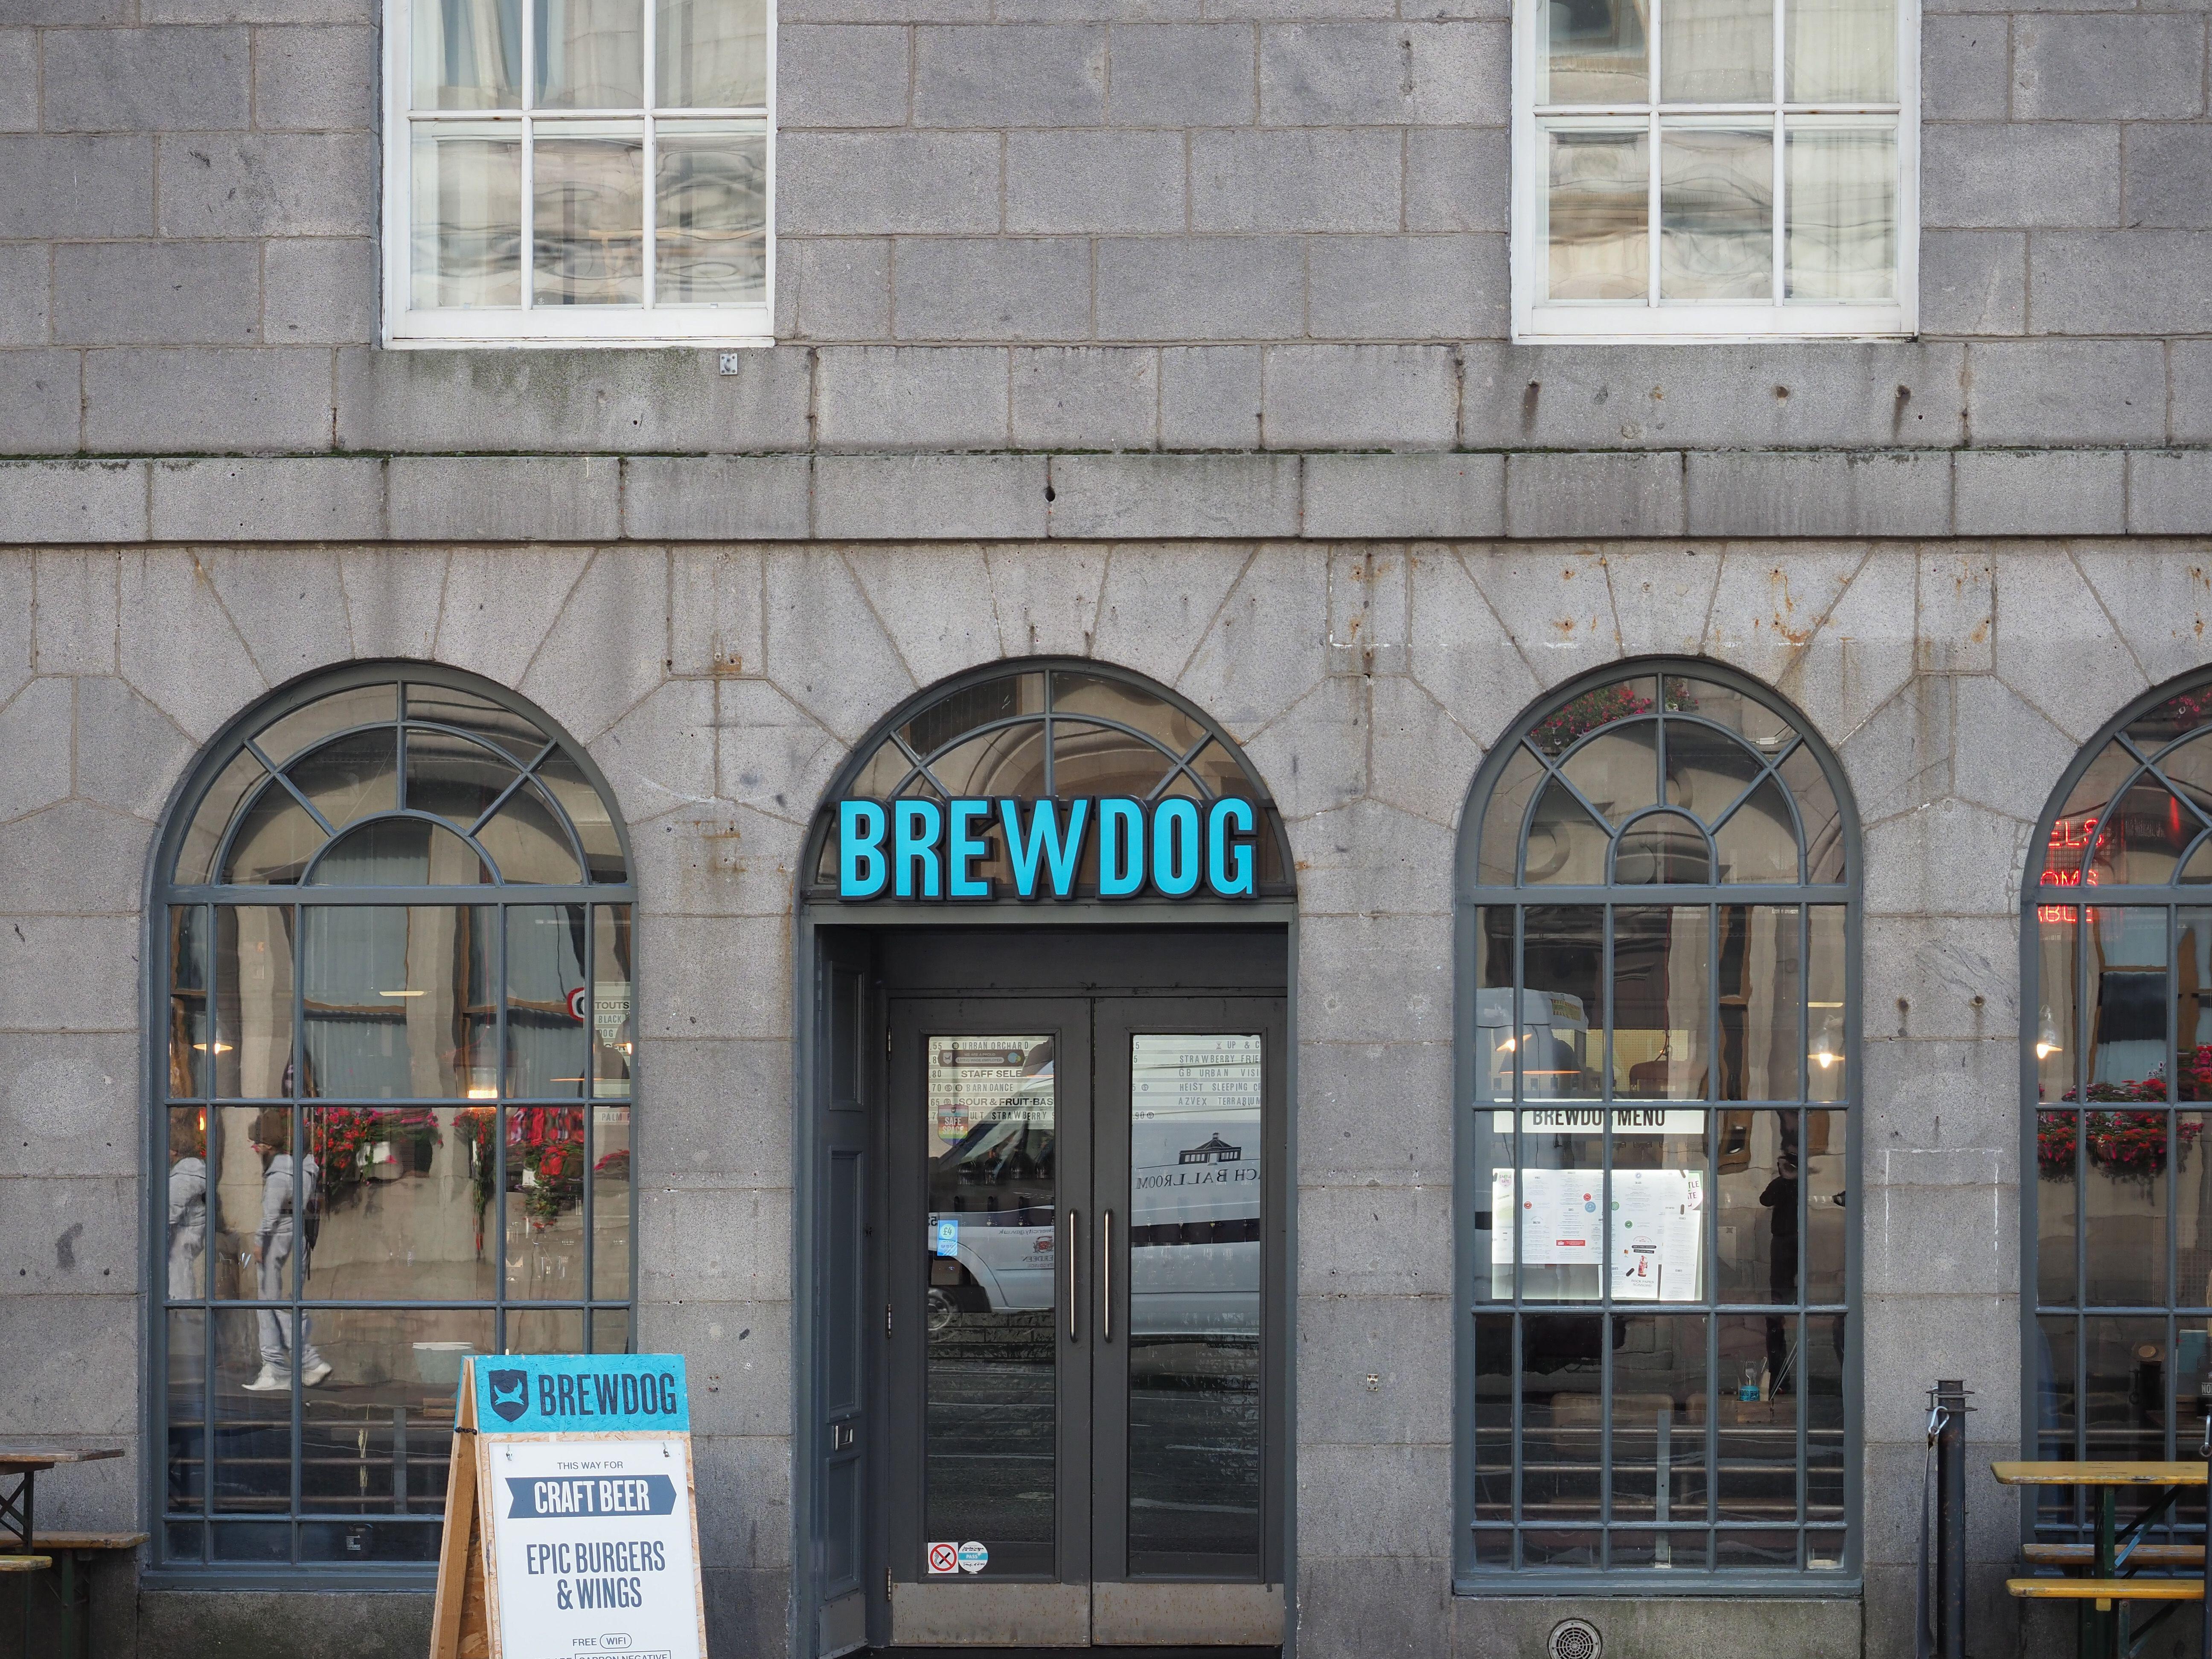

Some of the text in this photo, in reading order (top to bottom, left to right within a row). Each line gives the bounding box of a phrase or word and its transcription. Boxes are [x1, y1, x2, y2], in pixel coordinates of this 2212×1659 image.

[837, 796, 1257, 901] BREWDOG
[598, 1015, 622, 1023] BLACK
[962, 1042, 988, 1050] URBAN
[991, 1041, 1029, 1050] ORCHARD
[1227, 1041, 1236, 1049] UP
[1179, 1055, 1235, 1063] STRAWBERRY
[1179, 1069, 1191, 1077] GB
[1199, 1068, 1228, 1077] URBAN
[990, 1083, 1013, 1091] DANCE
[1179, 1083, 1203, 1091] HEIST
[1212, 1082, 1248, 1091] SLEEPING
[1179, 1097, 1207, 1106] AZVEX
[602, 1113, 622, 1121] PALM
[992, 1111, 1047, 1121] STRAWBERRY
[1533, 1110, 1664, 1126] BREWDO MENU
[945, 1117, 962, 1126] SAFE
[943, 1126, 964, 1135] SPACE
[943, 1227, 952, 1235] £4
[2202, 1384, 2212, 1394] NO
[538, 1373, 677, 1416] BREWDOG
[534, 1479, 650, 1513] CRAFT BEER
[527, 1540, 666, 1575] EPIC BURGERS
[557, 1577, 642, 1610] & WINGS
[572, 1637, 626, 1647] FREE WIFI
